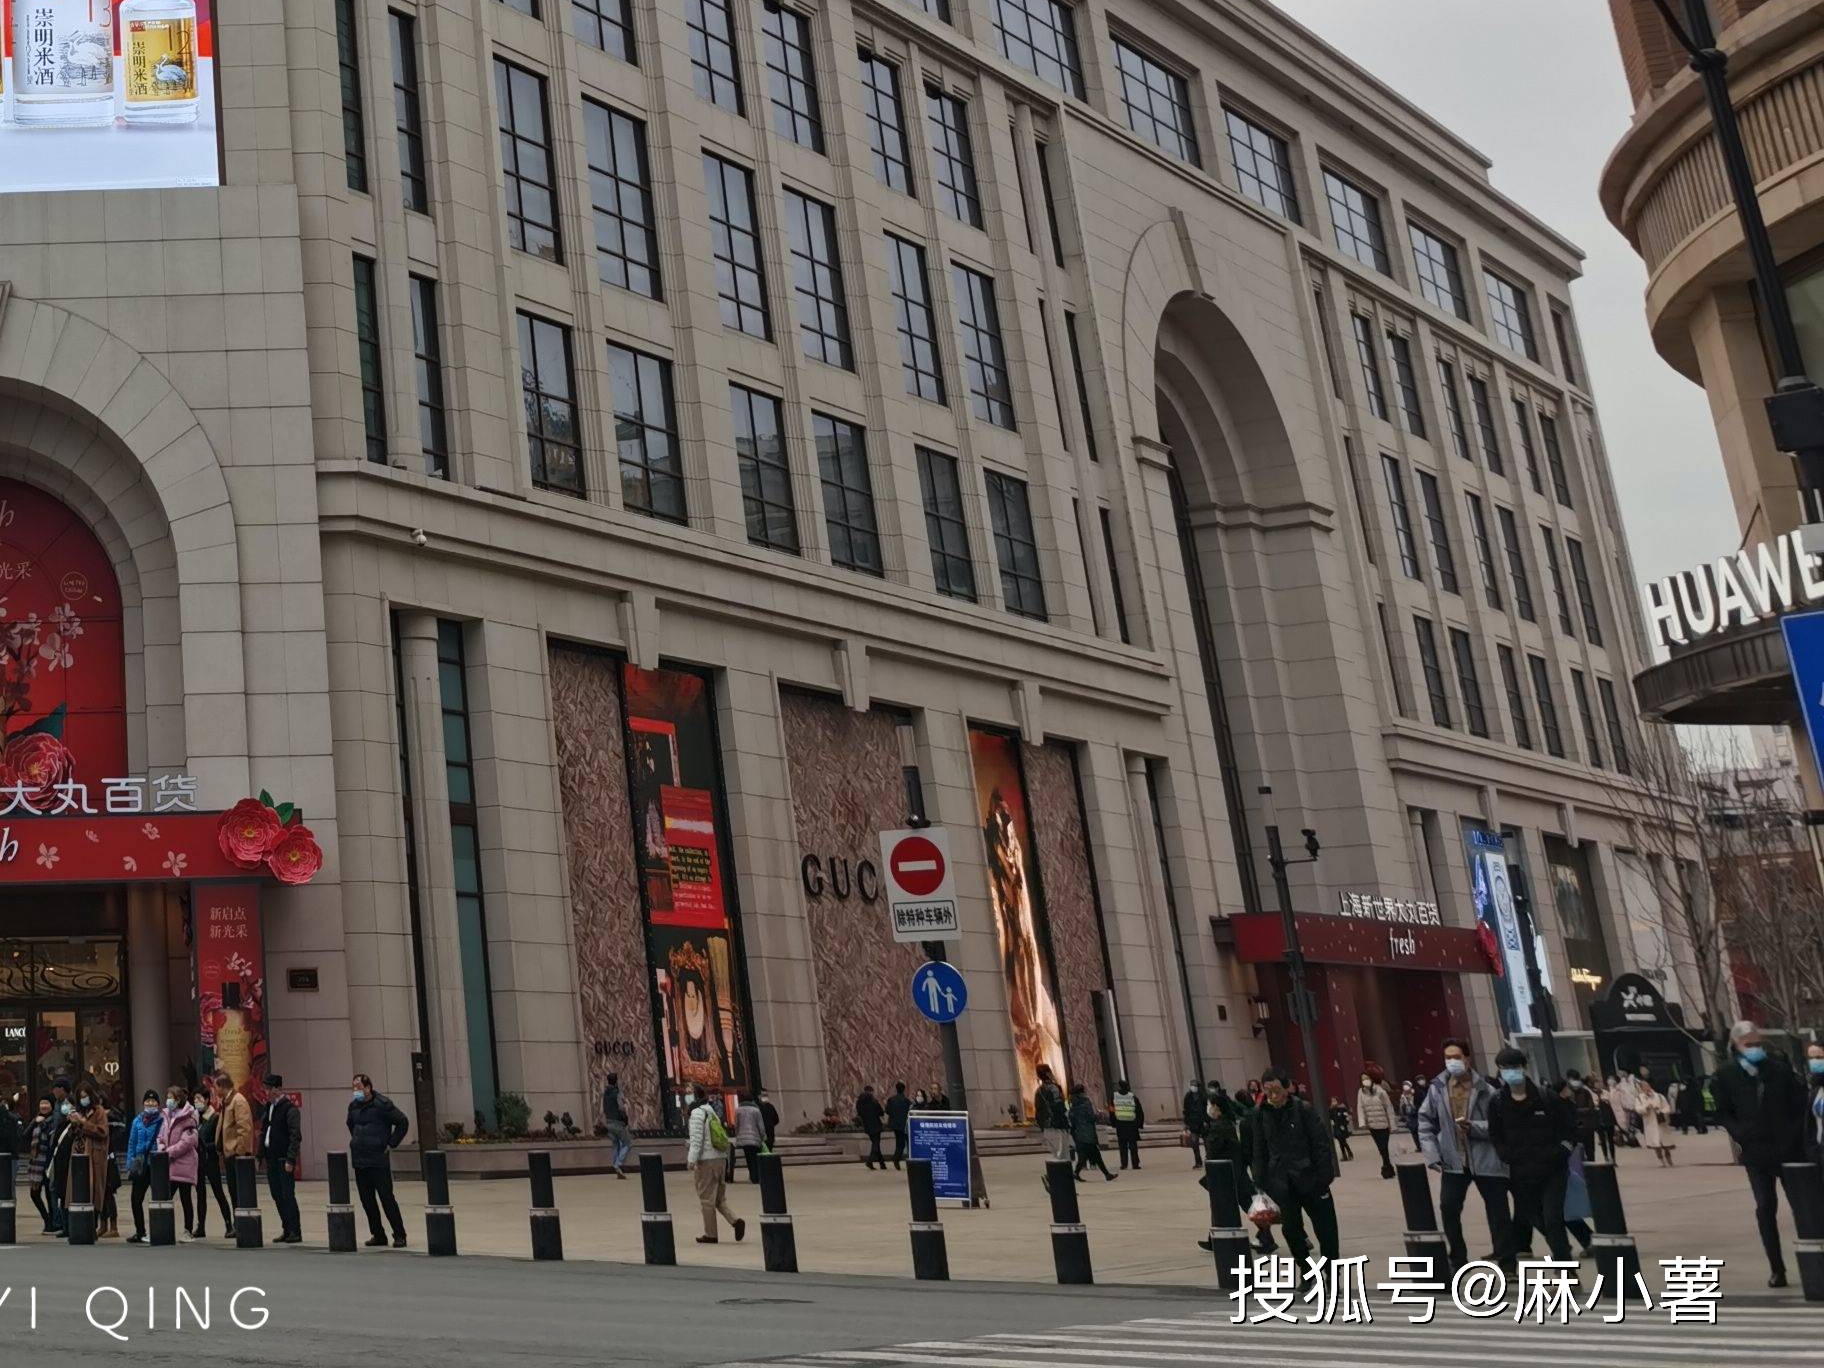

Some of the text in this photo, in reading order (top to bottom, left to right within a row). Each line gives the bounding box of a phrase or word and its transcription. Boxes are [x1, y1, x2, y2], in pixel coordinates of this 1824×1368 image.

[33, 6, 56, 87] 崇明米酒
[132, 40, 149, 97] 崇明米酒
[209, 906, 247, 922] 新启点
[895, 905, 953, 928] 除特种车辆外
[1338, 890, 1441, 925] 上海新世界大丸百货
[209, 924, 249, 939] 新光采
[1389, 927, 1417, 961] fresh
[594, 1040, 636, 1056] GUCCI
